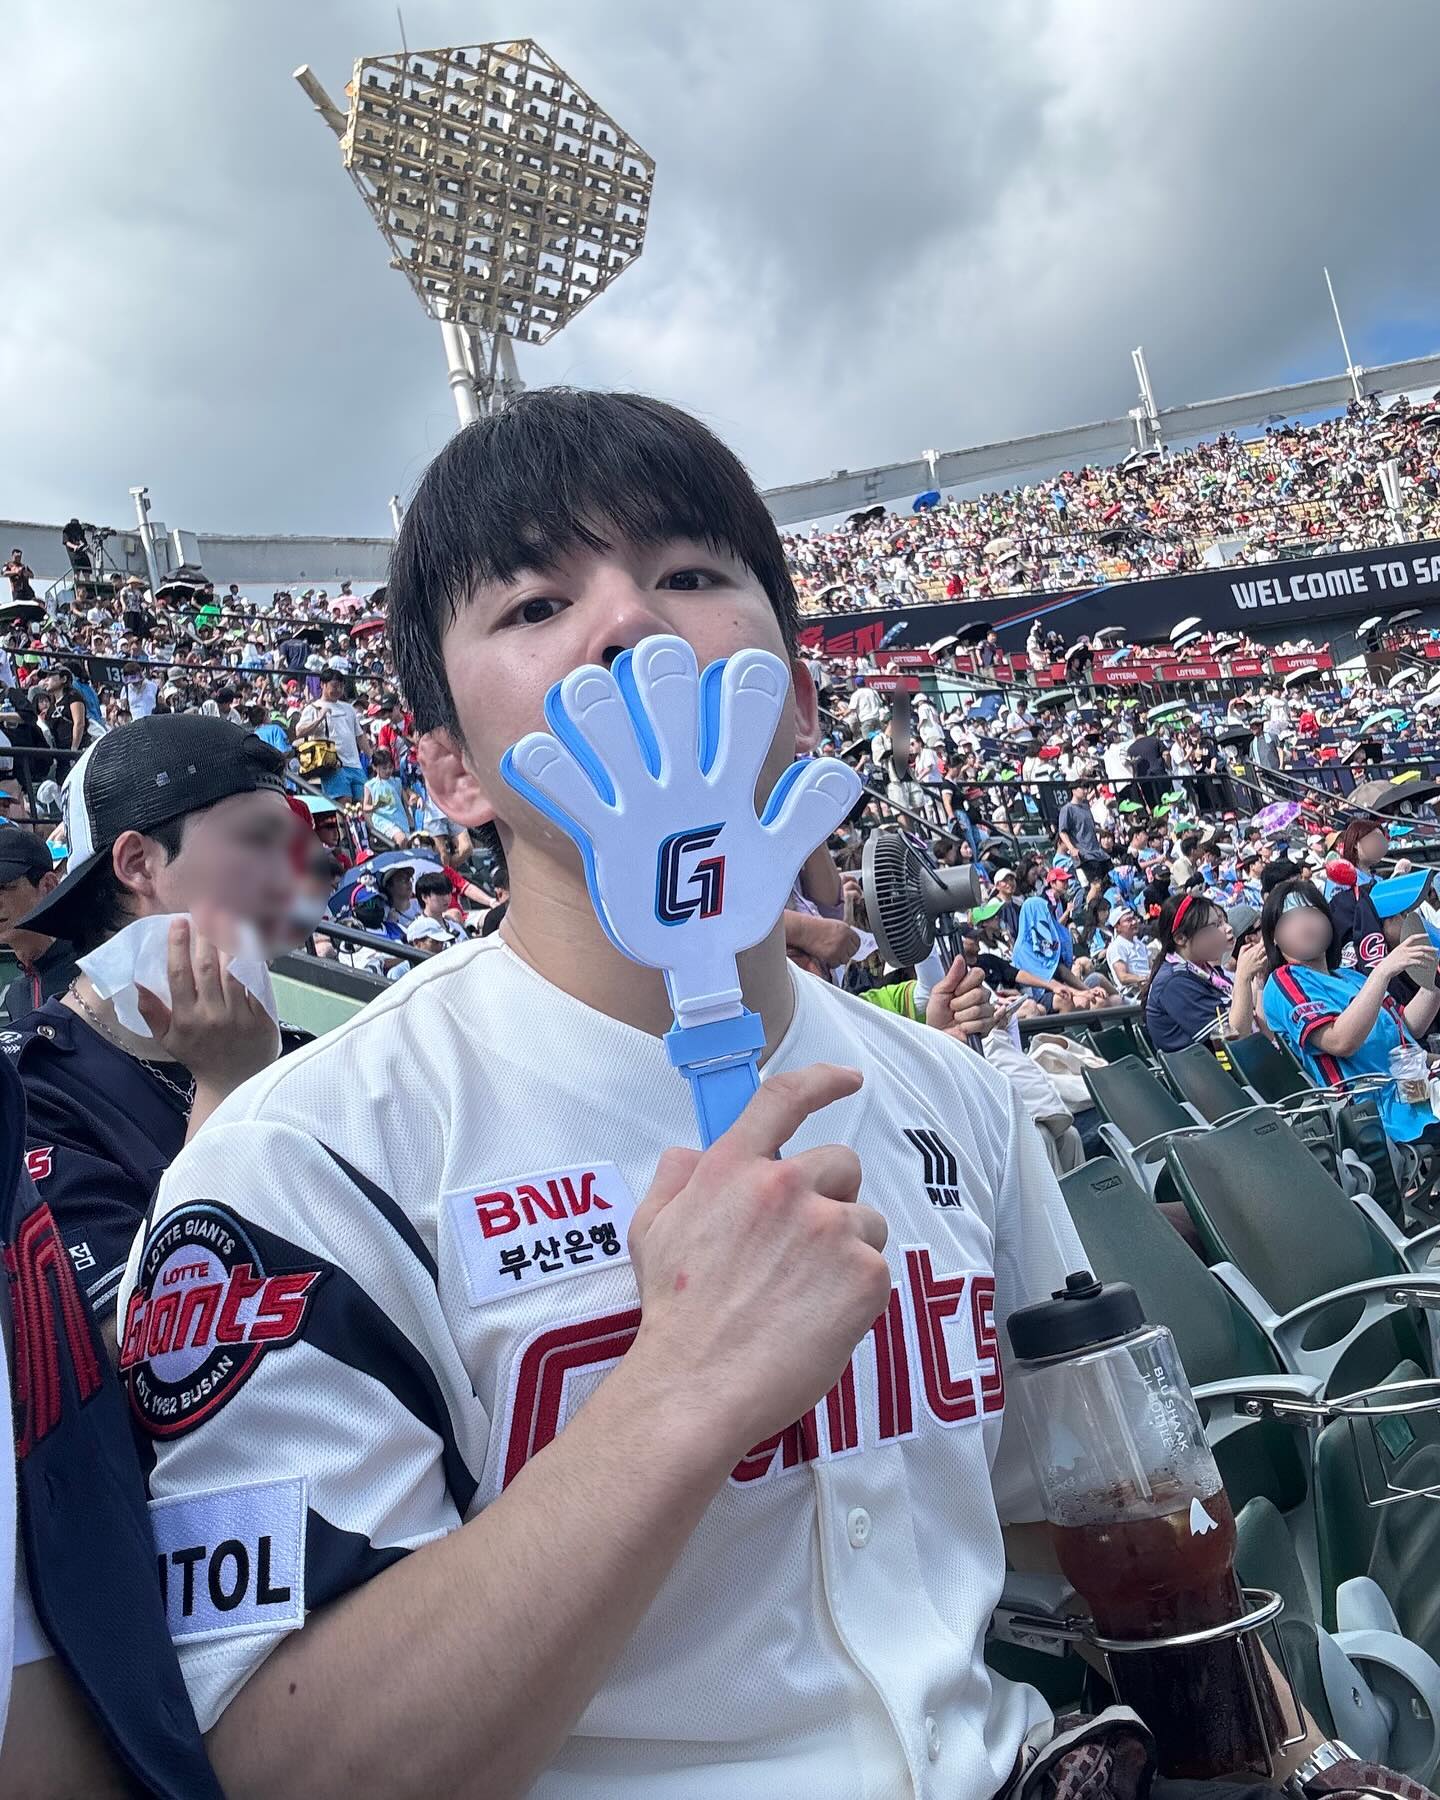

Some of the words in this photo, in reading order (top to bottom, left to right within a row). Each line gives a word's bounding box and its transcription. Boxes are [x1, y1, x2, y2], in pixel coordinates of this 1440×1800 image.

[1231, 567, 1368, 610] WELCOME
[1370, 561, 1409, 590] TO
[1106, 671, 1138, 681] LOTTERIA
[1176, 667, 1207, 677] LOTTERIA
[1287, 659, 1318, 669] LOTTERIA
[655, 821, 727, 927] G
[474, 1172, 613, 1239] BNK
[926, 1187, 962, 1208] PLAY
[147, 1223, 182, 1274] LOTTE
[184, 1219, 236, 1256] GIANTS
[499, 1222, 621, 1281] 부산은행
[162, 1261, 209, 1287] LOTTE
[180, 1355, 234, 1409] BUSAN
[1143, 1372, 1153, 1391] 1L
[1154, 1366, 1170, 1396] BLU
[1165, 1399, 1189, 1452] SHAAK
